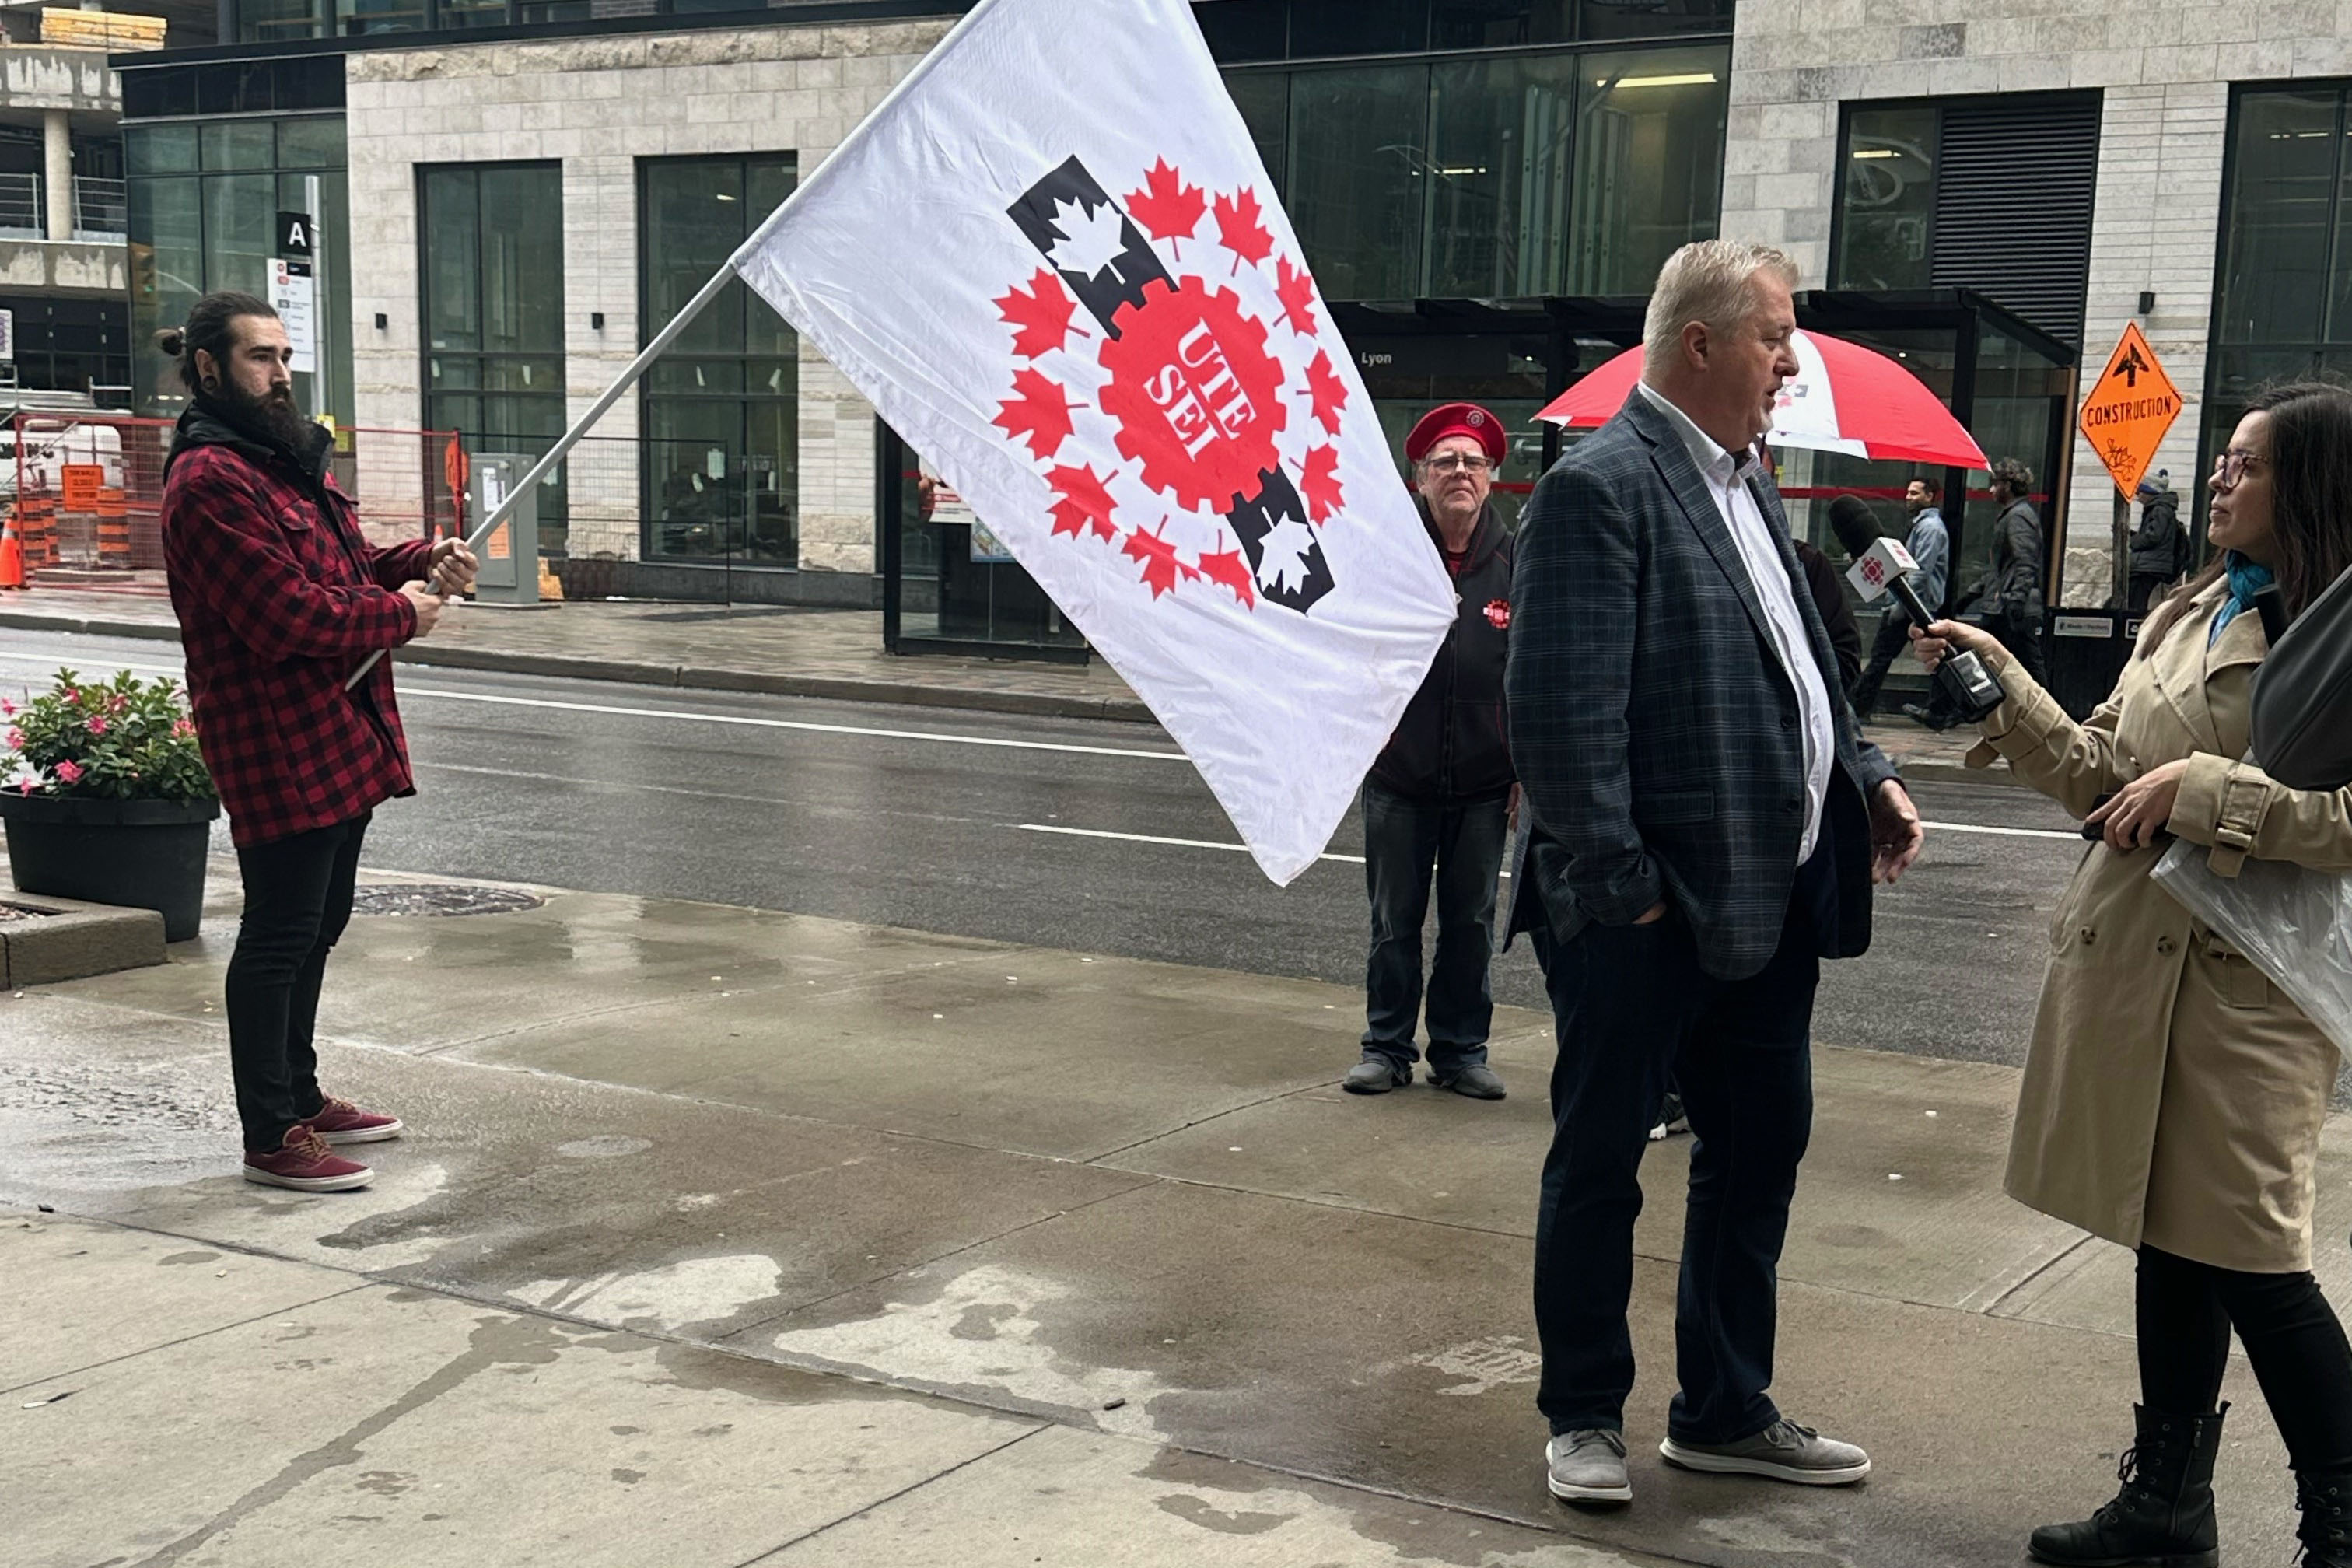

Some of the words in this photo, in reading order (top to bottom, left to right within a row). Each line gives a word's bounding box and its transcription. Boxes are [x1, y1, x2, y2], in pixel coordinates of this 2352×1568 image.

[289, 222, 306, 247] A
[1361, 352, 1392, 367] Lyon
[1178, 316, 1257, 440] UTE
[1142, 364, 1220, 462] SEI
[2087, 396, 2171, 427] CONSTRUCTION
